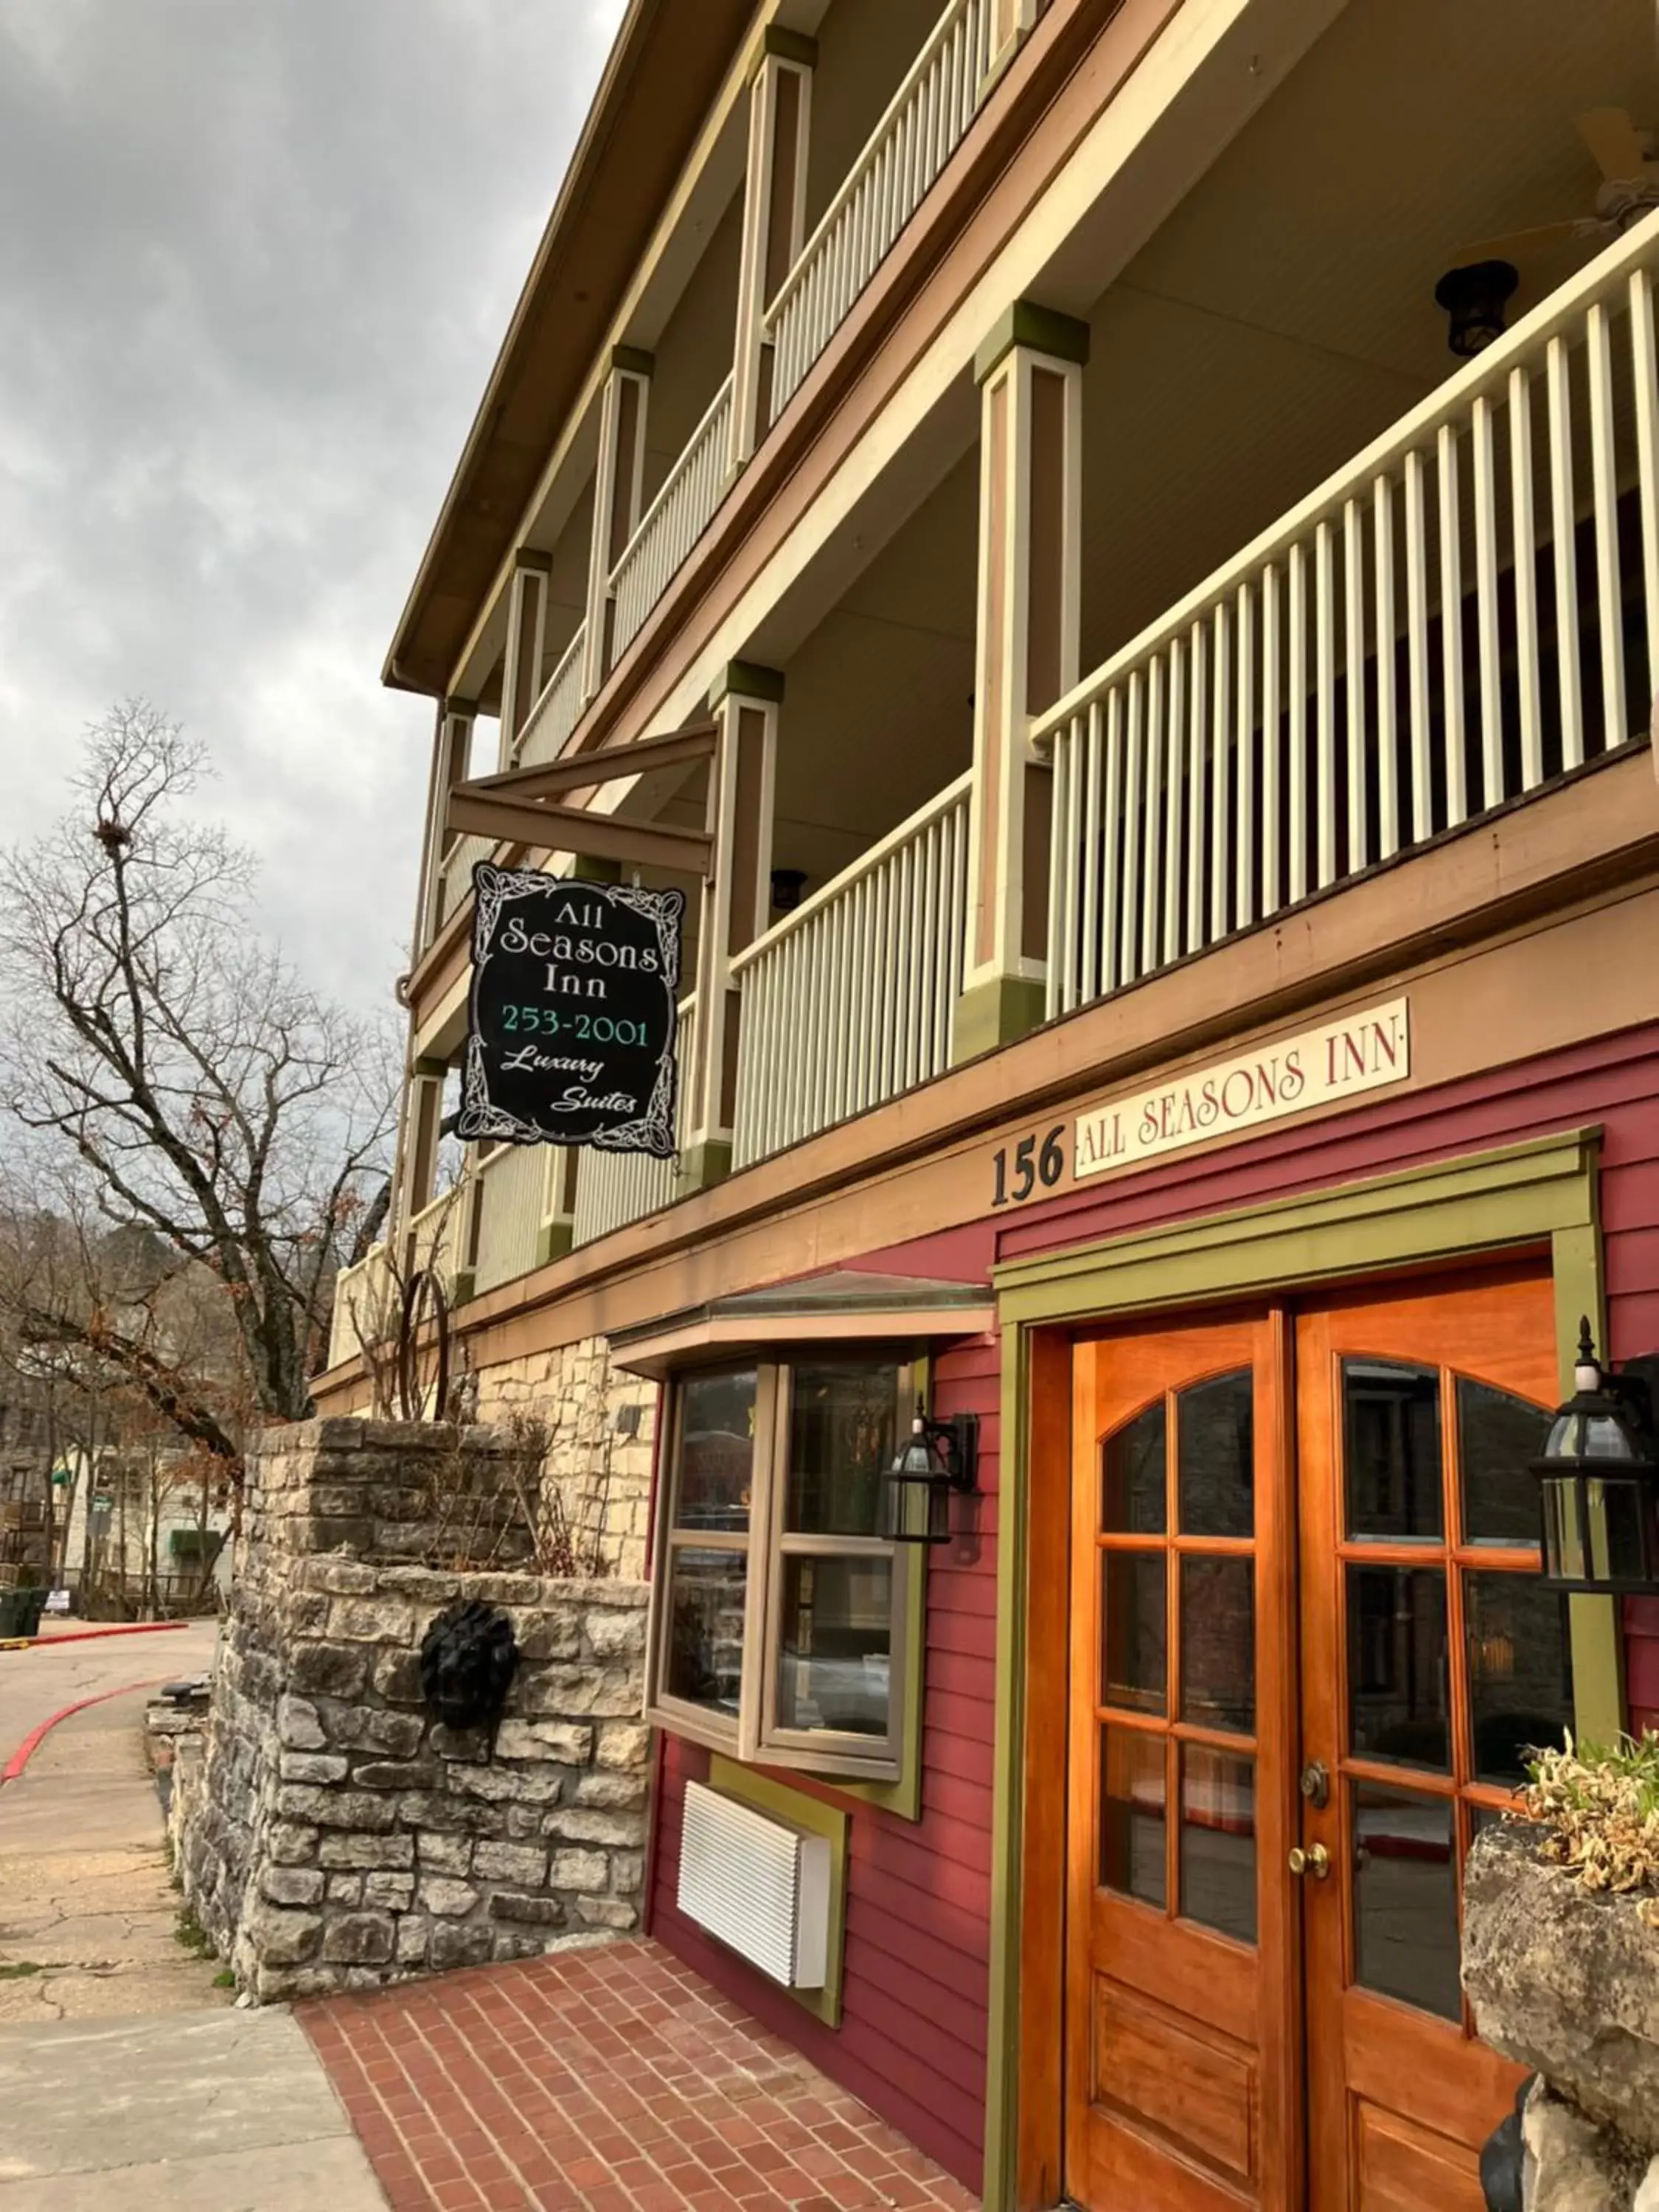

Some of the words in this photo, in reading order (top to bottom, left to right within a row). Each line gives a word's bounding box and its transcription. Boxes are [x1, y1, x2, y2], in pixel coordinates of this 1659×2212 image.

[554, 902, 602, 929] All
[501, 917, 658, 972] Seasons
[543, 964, 607, 998] Inn
[502, 1004, 647, 1046] 253-2001
[500, 1044, 604, 1082] Luxury
[550, 1085, 637, 1113] Suites
[1079, 1113, 1125, 1166] ALL
[1138, 1048, 1304, 1146] SEASONS
[1325, 1015, 1399, 1086] INN
[991, 1124, 1066, 1206] 156
